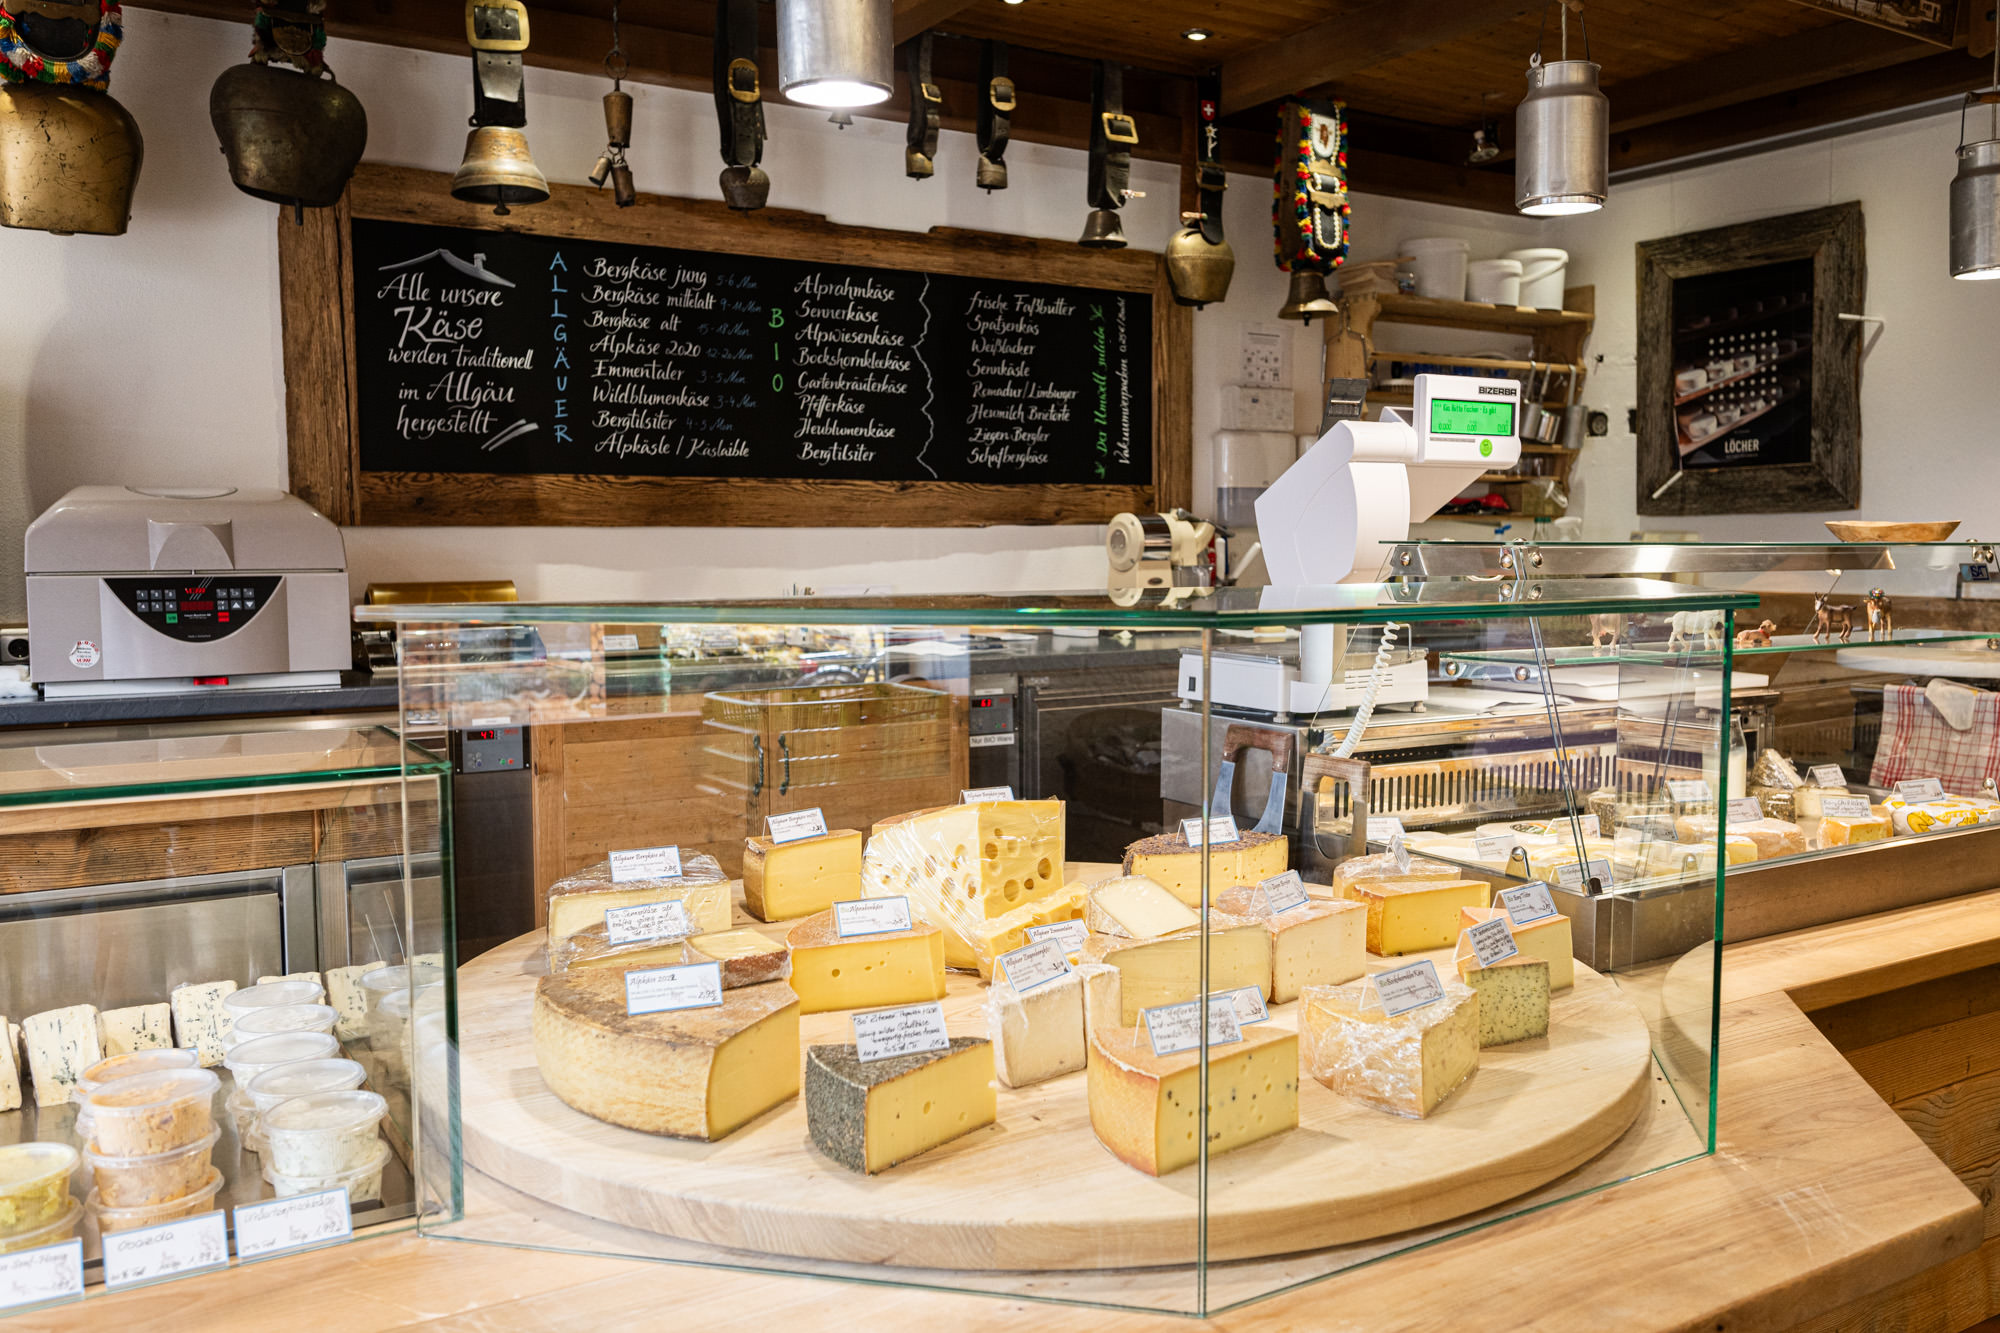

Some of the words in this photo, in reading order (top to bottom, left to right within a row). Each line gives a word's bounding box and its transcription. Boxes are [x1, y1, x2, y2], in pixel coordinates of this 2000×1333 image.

[583, 256, 667, 285] Bergkäse
[668, 265, 707, 290] jung
[377, 272, 431, 301] Alle
[441, 288, 504, 307] unsere
[581, 281, 660, 308] Bergkäse
[666, 288, 717, 310] mittelalt
[794, 272, 895, 301] Alprahmkäse
[795, 299, 879, 323] Sennerkäse
[965, 290, 1009, 316] frische
[1013, 294, 1077, 317] Faßbutter
[394, 305, 483, 348] Käse
[583, 307, 650, 334] Bergkäse
[660, 313, 682, 332] alt
[966, 313, 1040, 336] Spatzenkäs
[589, 332, 661, 362] Alpkäse
[665, 340, 702, 358] 2020
[794, 322, 905, 347] Alpwiesenkäse
[971, 336, 1037, 357] Weißlacker
[388, 342, 448, 366] werden
[451, 343, 534, 370] traditionell
[792, 346, 912, 372] Bockshornkleekäse
[966, 358, 1031, 378] Sennkäsle
[590, 358, 685, 382] Emmentaler
[794, 370, 908, 396] Gartenkräuterkäse
[398, 382, 420, 400] im
[426, 370, 516, 410] Allgäu
[591, 379, 710, 407] Wildblumenkäse
[1479, 386, 1517, 397] BIZERBA
[798, 392, 866, 419] Pfefferkäse
[396, 403, 499, 440] hergestellt
[592, 408, 678, 434] Bergtilsiter
[794, 417, 896, 439] Heublumenkäse
[594, 432, 670, 460] Alpkäsle
[684, 437, 751, 460] Käslaible
[968, 427, 1010, 447] Ziegen
[1009, 425, 1051, 447] Bergler
[1724, 438, 1760, 455] LÖCHER
[796, 441, 877, 467] Bergtilsiter
[966, 444, 1050, 471] Schafbergkäse
[984, 736, 996, 744] BIO
